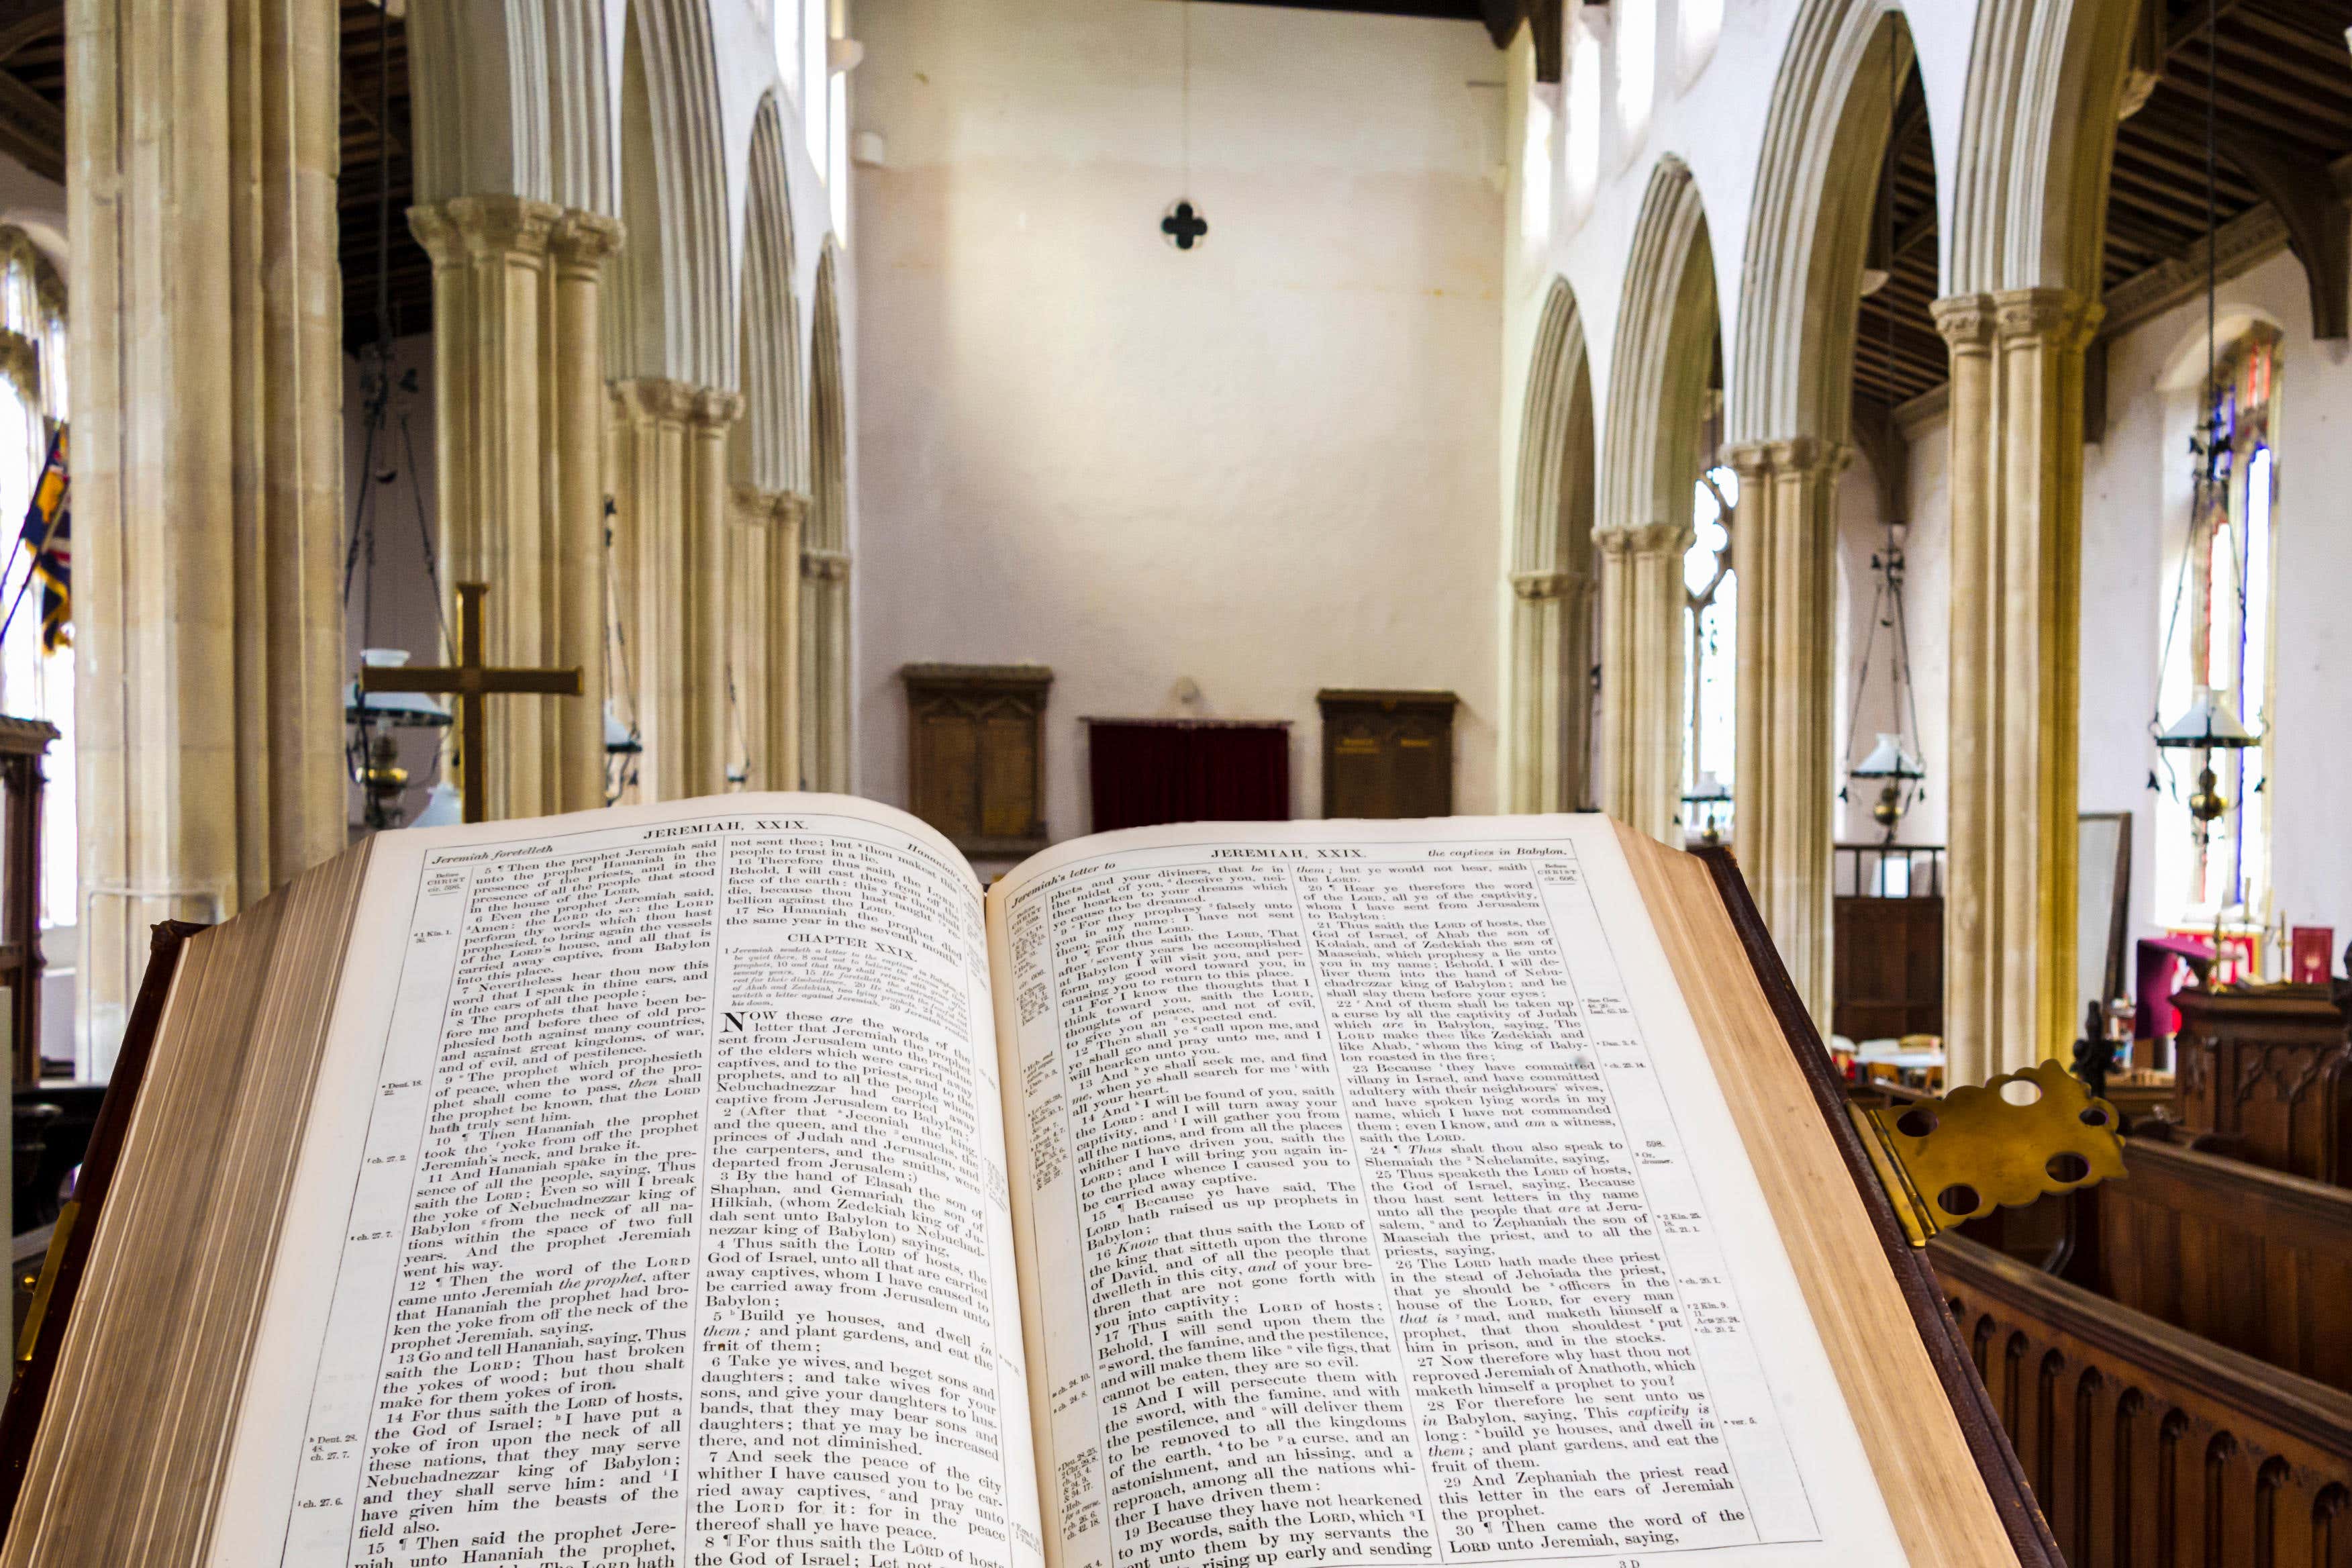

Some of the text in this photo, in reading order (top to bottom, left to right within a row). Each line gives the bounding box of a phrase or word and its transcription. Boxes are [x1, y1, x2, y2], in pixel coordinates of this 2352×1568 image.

[643, 821, 808, 839] JEREMIAH, XXIX.
[432, 845, 553, 865] Jeremiah foretelleth
[1211, 849, 1366, 861] JEREMIAH, XXIX.
[1450, 849, 1493, 858] captives
[1517, 848, 1567, 856] Babylon.
[427, 877, 465, 885] CHRIST
[1012, 875, 1065, 909] Jeremiah's
[1070, 866, 1099, 878] letter
[726, 917, 748, 925] the
[827, 918, 839, 926] in
[844, 920, 865, 929] the
[458, 940, 710, 975] carried away captive, from Babylon
[788, 934, 918, 962] CHAPTER XXIX.
[456, 977, 482, 985] into
[516, 968, 554, 979] place.
[480, 976, 562, 991] Nevertheless
[572, 973, 601, 981] hear
[610, 968, 640, 977] thou
[648, 965, 676, 973] now
[684, 961, 709, 970] this
[1061, 984, 1089, 997] form
[1098, 976, 1116, 985] my
[1125, 967, 1157, 981] good
[1165, 963, 1196, 973] word
[1205, 960, 1248, 969] toward
[1259, 961, 1286, 973] you,
[1320, 967, 1350, 977] liver
[1358, 969, 1390, 977] them
[1465, 969, 1497, 977] hand
[1525, 968, 1563, 976] Nebu-
[720, 1011, 778, 1032] NOW
[786, 1011, 822, 1021] these
[861, 1018, 883, 1029] the
[892, 1026, 929, 1042] words
[936, 1042, 948, 1050] of
[718, 1059, 912, 1083] captives, and to the priests,
[409, 1213, 692, 1250] tions within the space of two full
[404, 1228, 691, 1267] years. And the prophet Jeremiah
[1413, 1272, 1436, 1282] the
[1445, 1271, 1484, 1282] stead
[1493, 1270, 1508, 1280] of
[1516, 1268, 1581, 1279] Jehoiada
[1589, 1267, 1612, 1276] the
[1620, 1265, 1665, 1278] priest,
[1098, 1314, 1385, 1360] Behold, I will send upon them the
[1103, 1381, 1150, 1404] cannot
[1156, 1377, 1175, 1387] be
[1182, 1369, 1229, 1381] eaten,
[1235, 1363, 1268, 1375] they
[1328, 1357, 1358, 1367] evil.
[1412, 1360, 1696, 1385] reproved Jeremiah of Anathoth, which
[372, 1420, 681, 1456] yoke of iron upon the neck of all
[699, 1434, 922, 1455] there, and not diminished.
[709, 1450, 1001, 1493] 7 And seek the peace of the city
[1444, 1463, 1729, 1487] 29 And Zephaniah the priest read
[696, 1517, 936, 1540] thereof shall ye have peace.
[1125, 1493, 1422, 1540] 19 Because they have not hearkened
[1448, 1533, 1679, 1553] LORD unto Jeremiah, saying,
